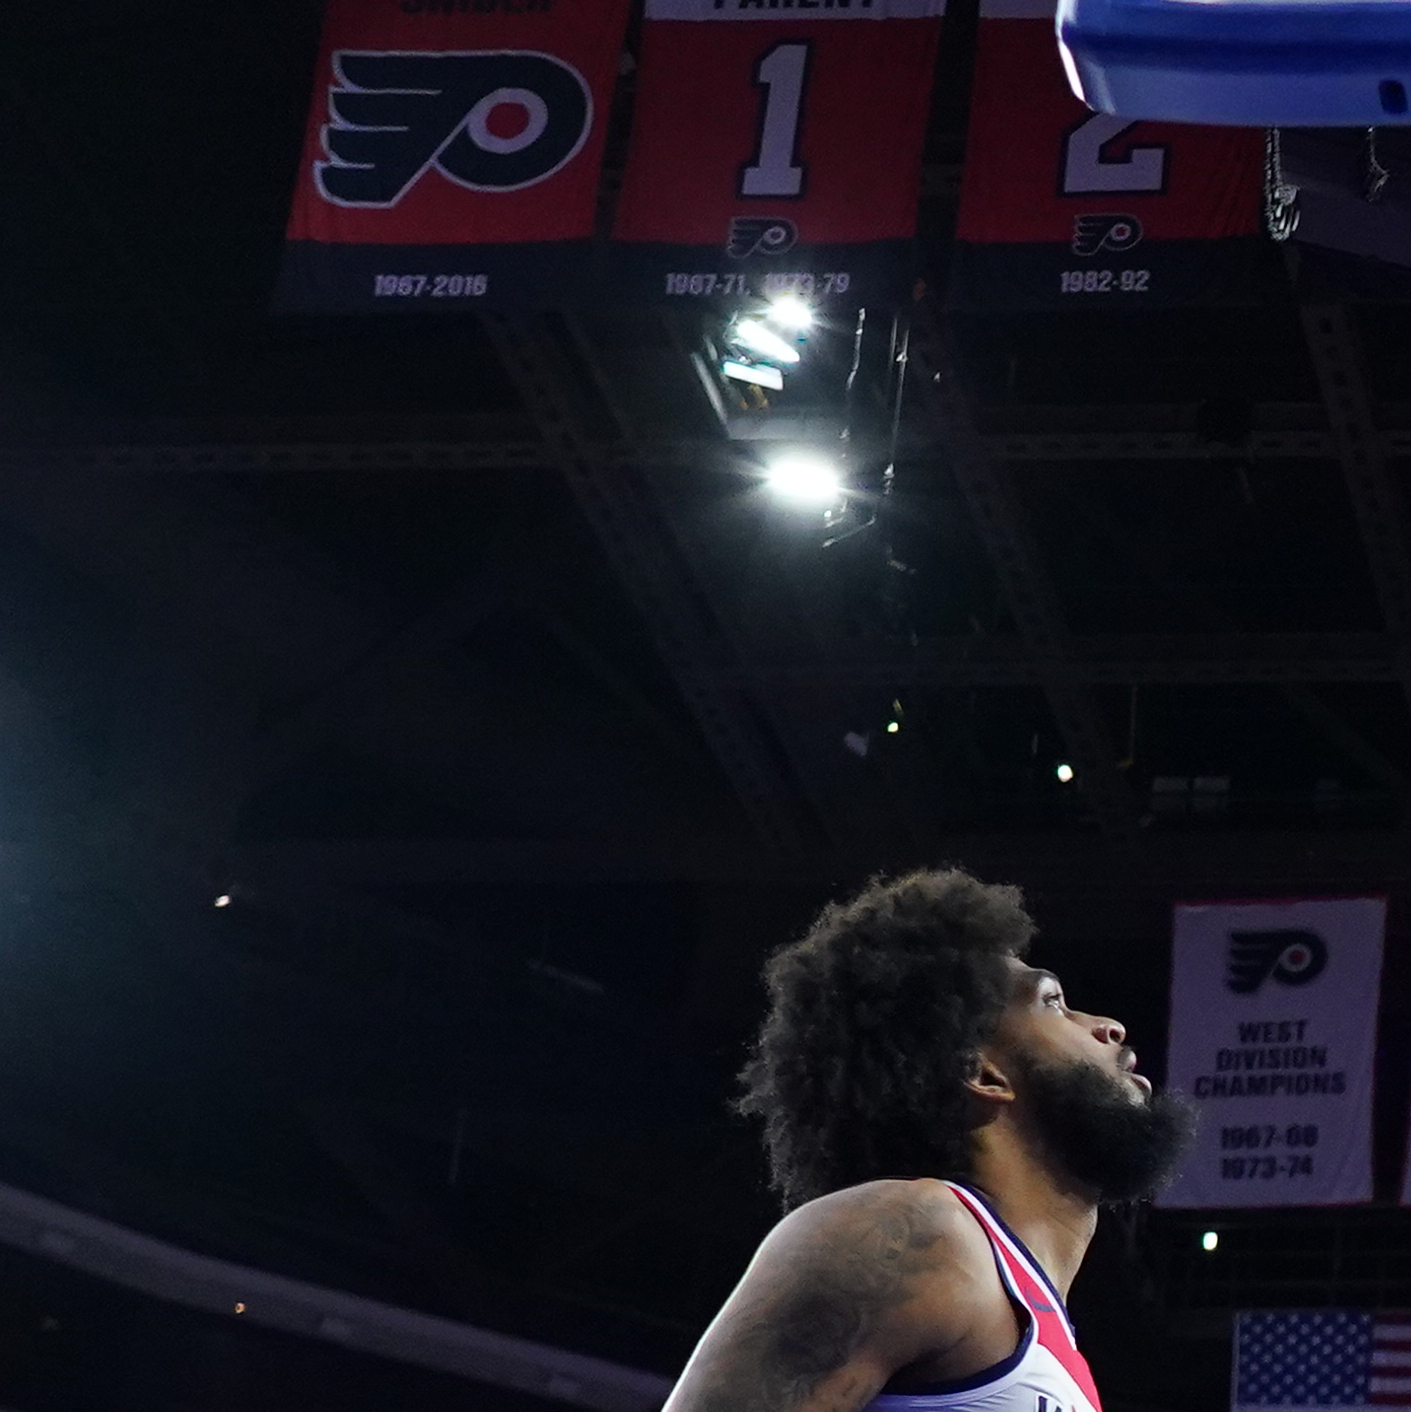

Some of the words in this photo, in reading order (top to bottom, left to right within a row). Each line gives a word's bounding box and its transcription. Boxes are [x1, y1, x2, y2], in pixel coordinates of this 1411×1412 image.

[1059, 269, 1151, 294] 1982-92
[1238, 1020, 1308, 1043] WEST
[1215, 1047, 1328, 1071] DIVISION
[1193, 1071, 1347, 1099] CHAMPIONS
[1220, 1154, 1314, 1181] 1973-74
